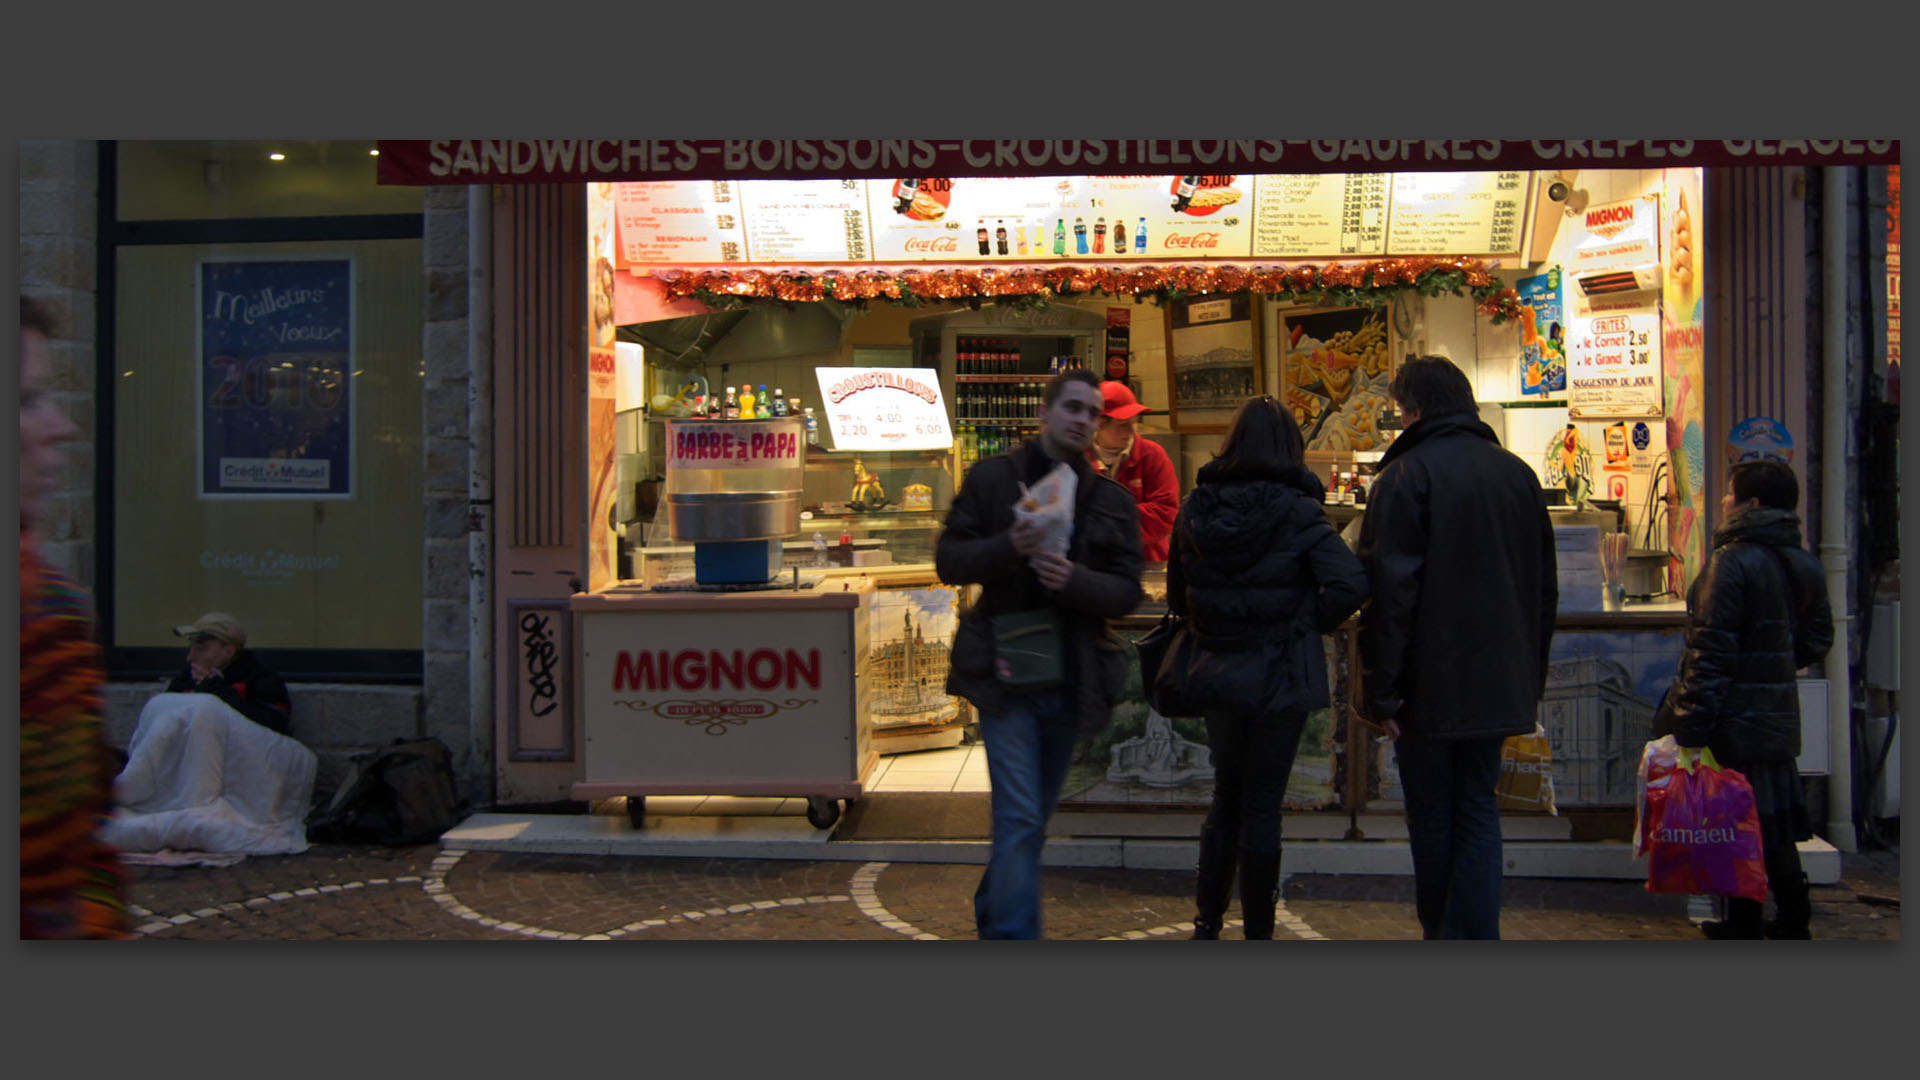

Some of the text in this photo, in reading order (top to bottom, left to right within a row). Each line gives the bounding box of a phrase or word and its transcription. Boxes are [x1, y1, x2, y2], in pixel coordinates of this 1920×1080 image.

[1586, 205, 1634, 228] MIGNON
[1596, 318, 1627, 331] FRITES
[1584, 336, 1626, 348] le Cornet
[1584, 353, 1622, 366] le Grand
[828, 371, 939, 404] CROUSTILLONS
[1572, 377, 1618, 388] SUGGESTION
[1633, 375, 1654, 386] JOUR
[677, 431, 734, 460] BARBE
[751, 431, 797, 459] PAPA
[225, 464, 325, 478] Crédit Mutuel
[613, 649, 821, 692] MIGNON
